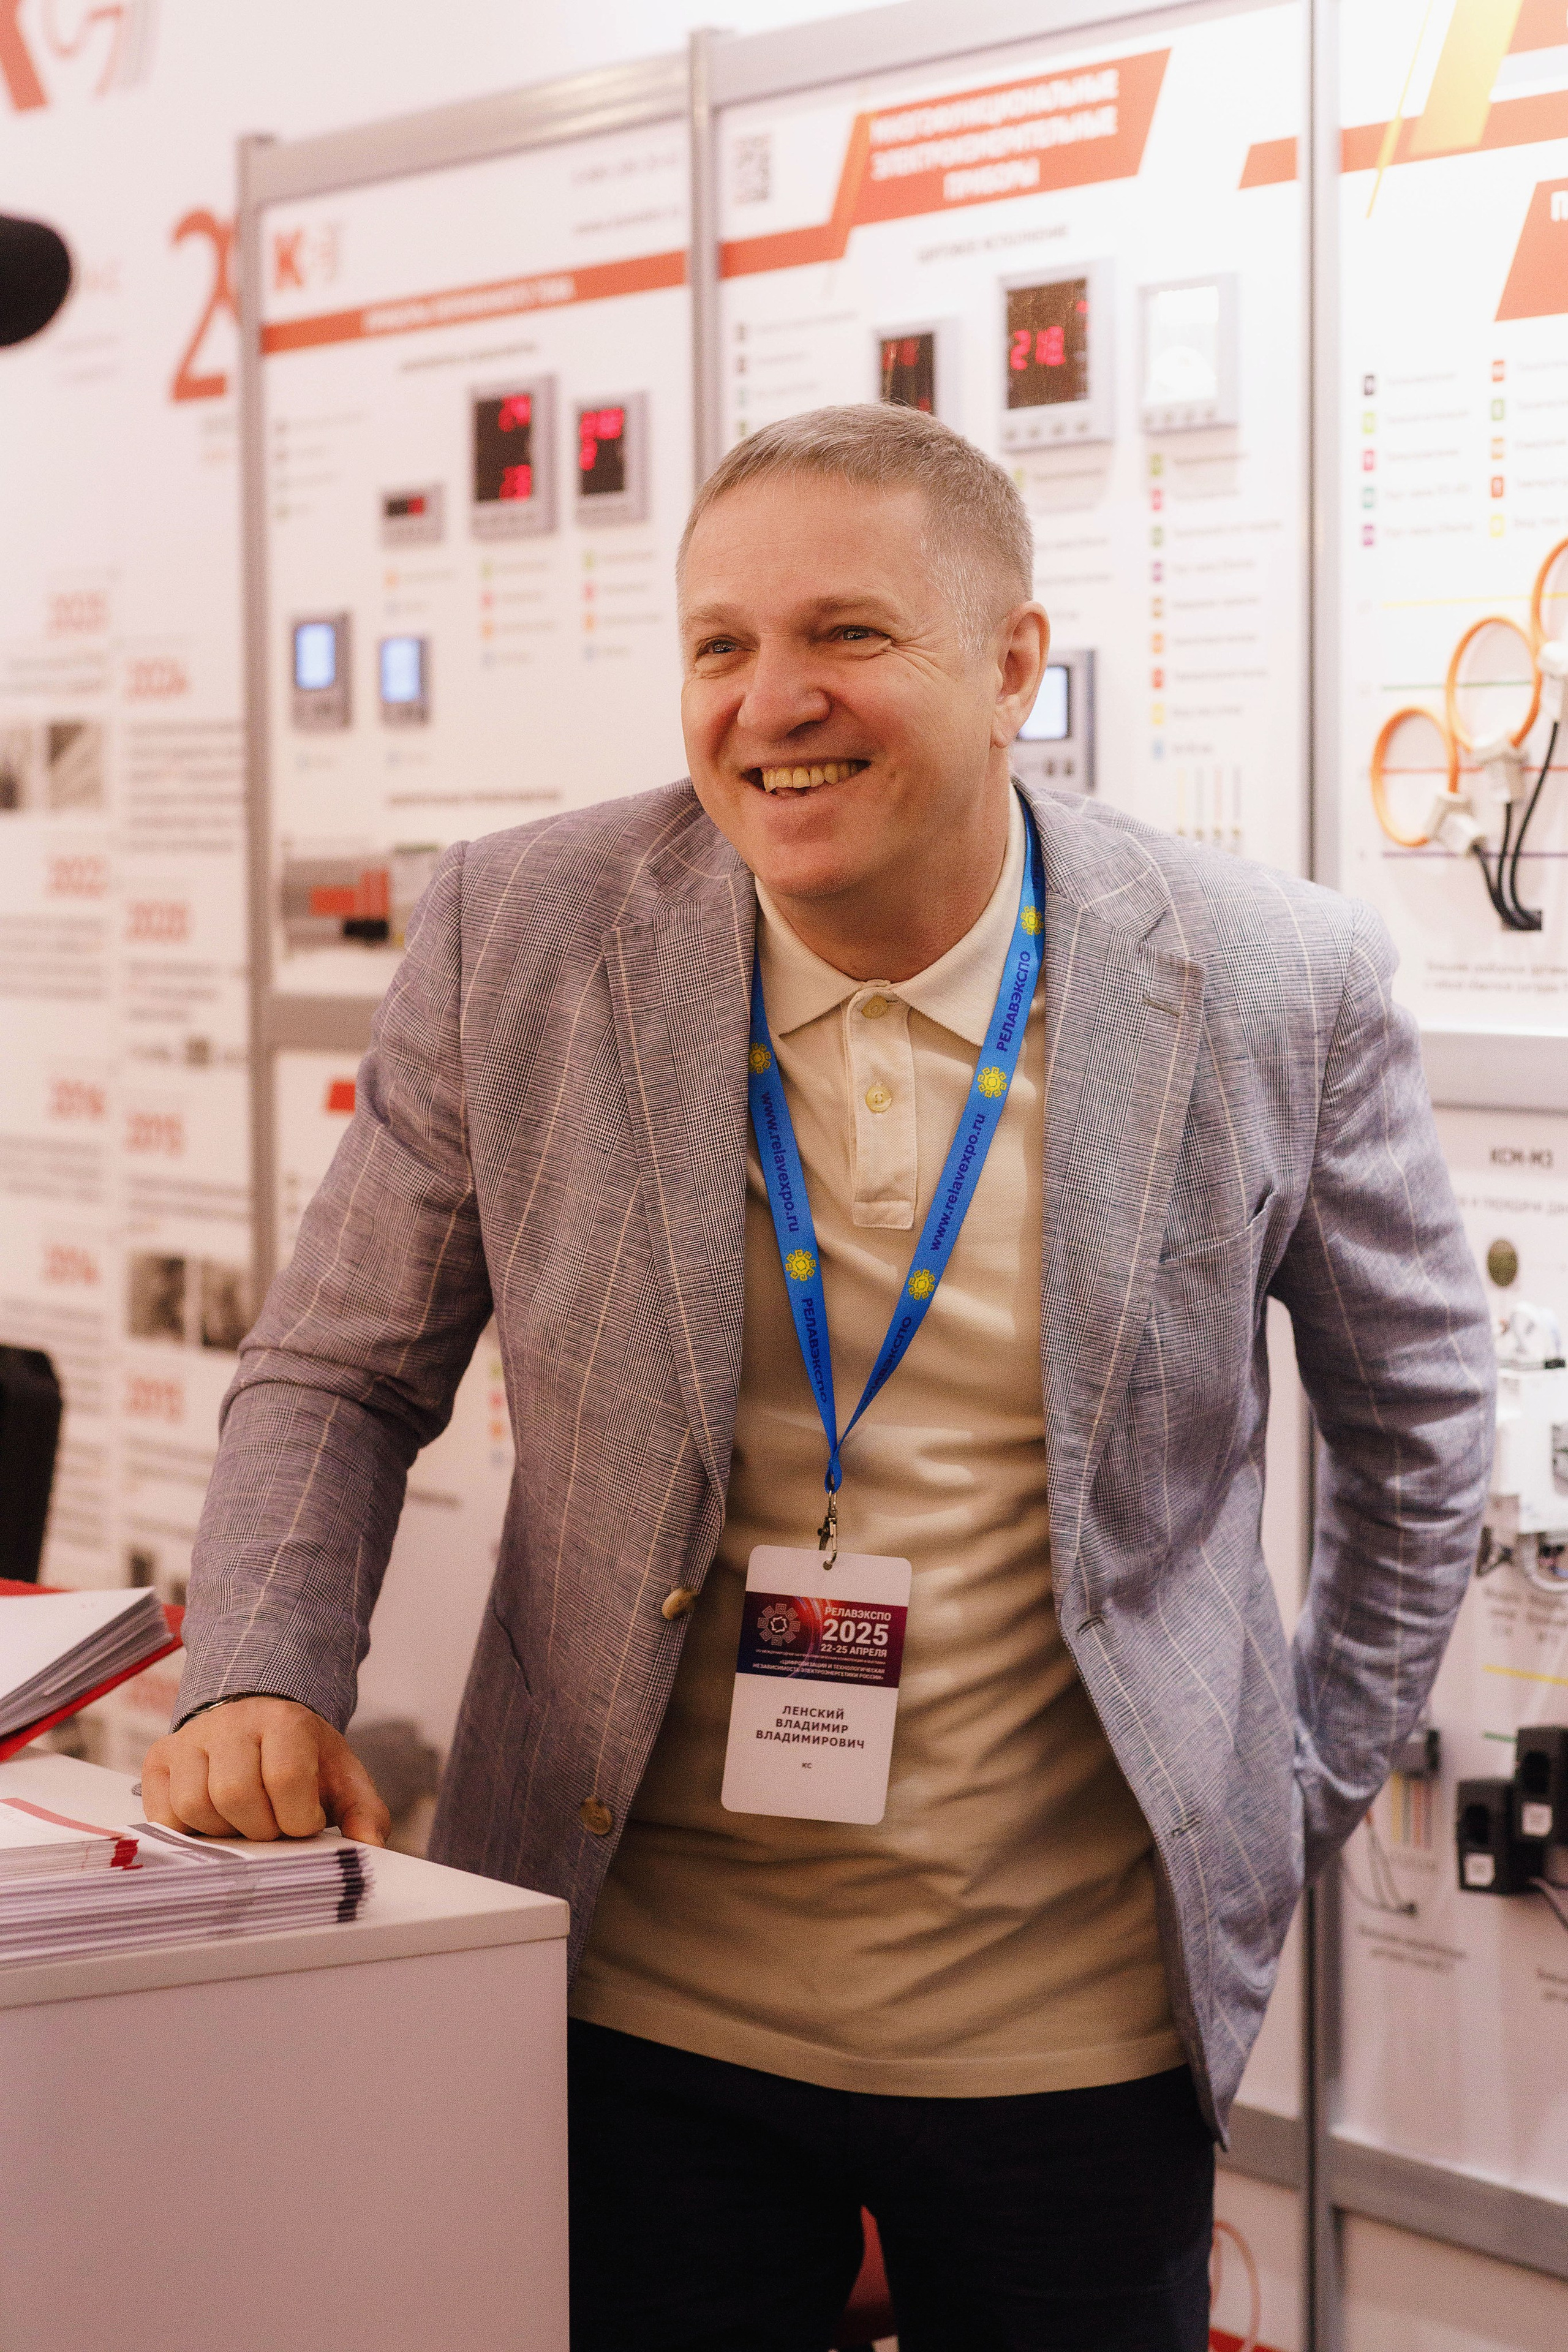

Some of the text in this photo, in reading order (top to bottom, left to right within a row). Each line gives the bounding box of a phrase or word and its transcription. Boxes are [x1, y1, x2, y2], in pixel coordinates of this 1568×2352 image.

[997, 951, 1030, 1052] РЕЛАВЭКСПО
[762, 1091, 799, 1232] www.relavexpo.ru
[930, 1114, 986, 1251] www.relavexpo.ru
[802, 1298, 827, 1403] РЕЛАВЭКСПО
[824, 1606, 891, 1621] РЕЛАВЭКСПО
[823, 1619, 889, 1646] 2025
[820, 1643, 848, 1654] 22-25
[850, 1646, 888, 1658] АПРЕЛЯ
[782, 1706, 844, 1720] ЛЕНСКИЙ
[775, 1718, 848, 1733] ВЛАДИМИР
[756, 1730, 865, 1749] ВЛАДИМИРОВИЧ
